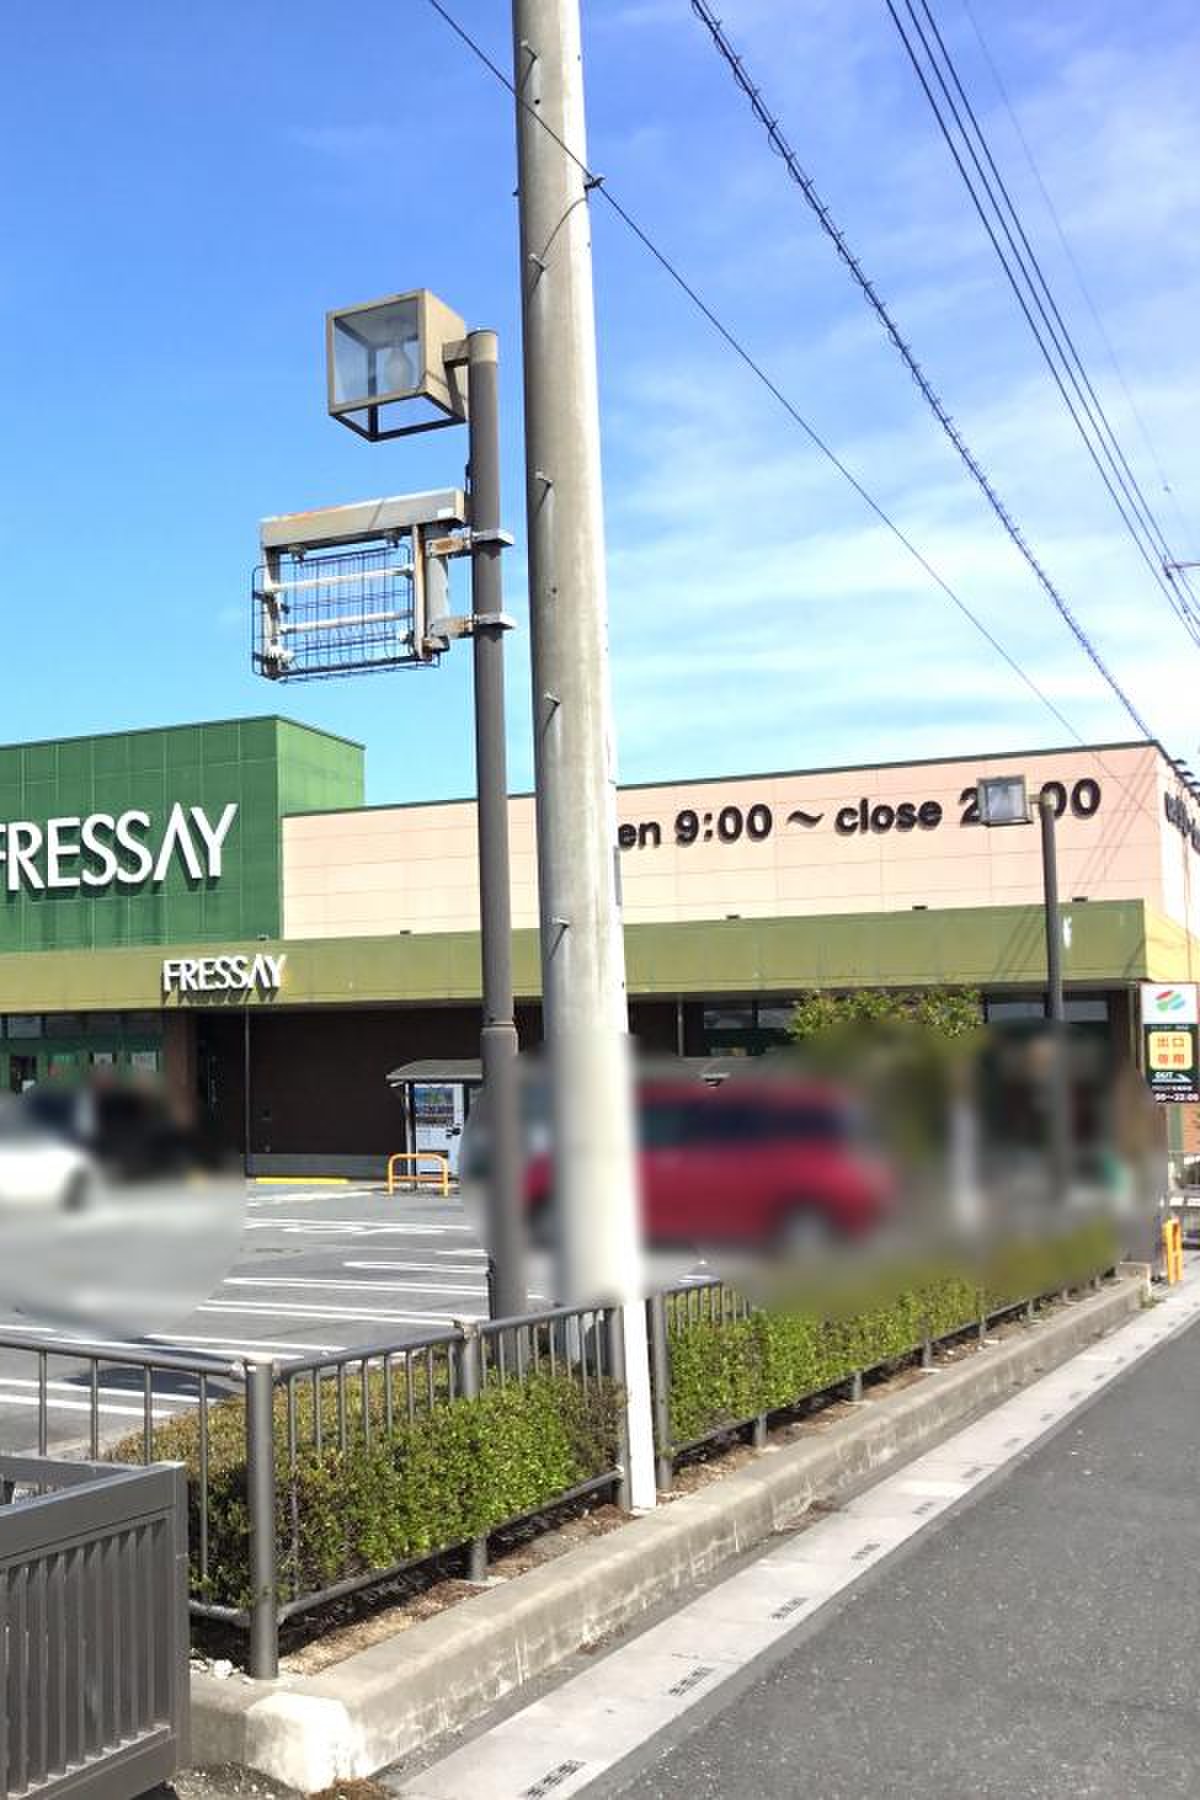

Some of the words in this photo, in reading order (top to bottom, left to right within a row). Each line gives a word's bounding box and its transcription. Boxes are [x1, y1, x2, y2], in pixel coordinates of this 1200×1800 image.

[617, 821, 661, 850] en
[674, 803, 773, 847] 9:00
[833, 796, 944, 836] close
[959, 777, 1101, 827] 200
[163, 954, 287, 991] FRESSAY
